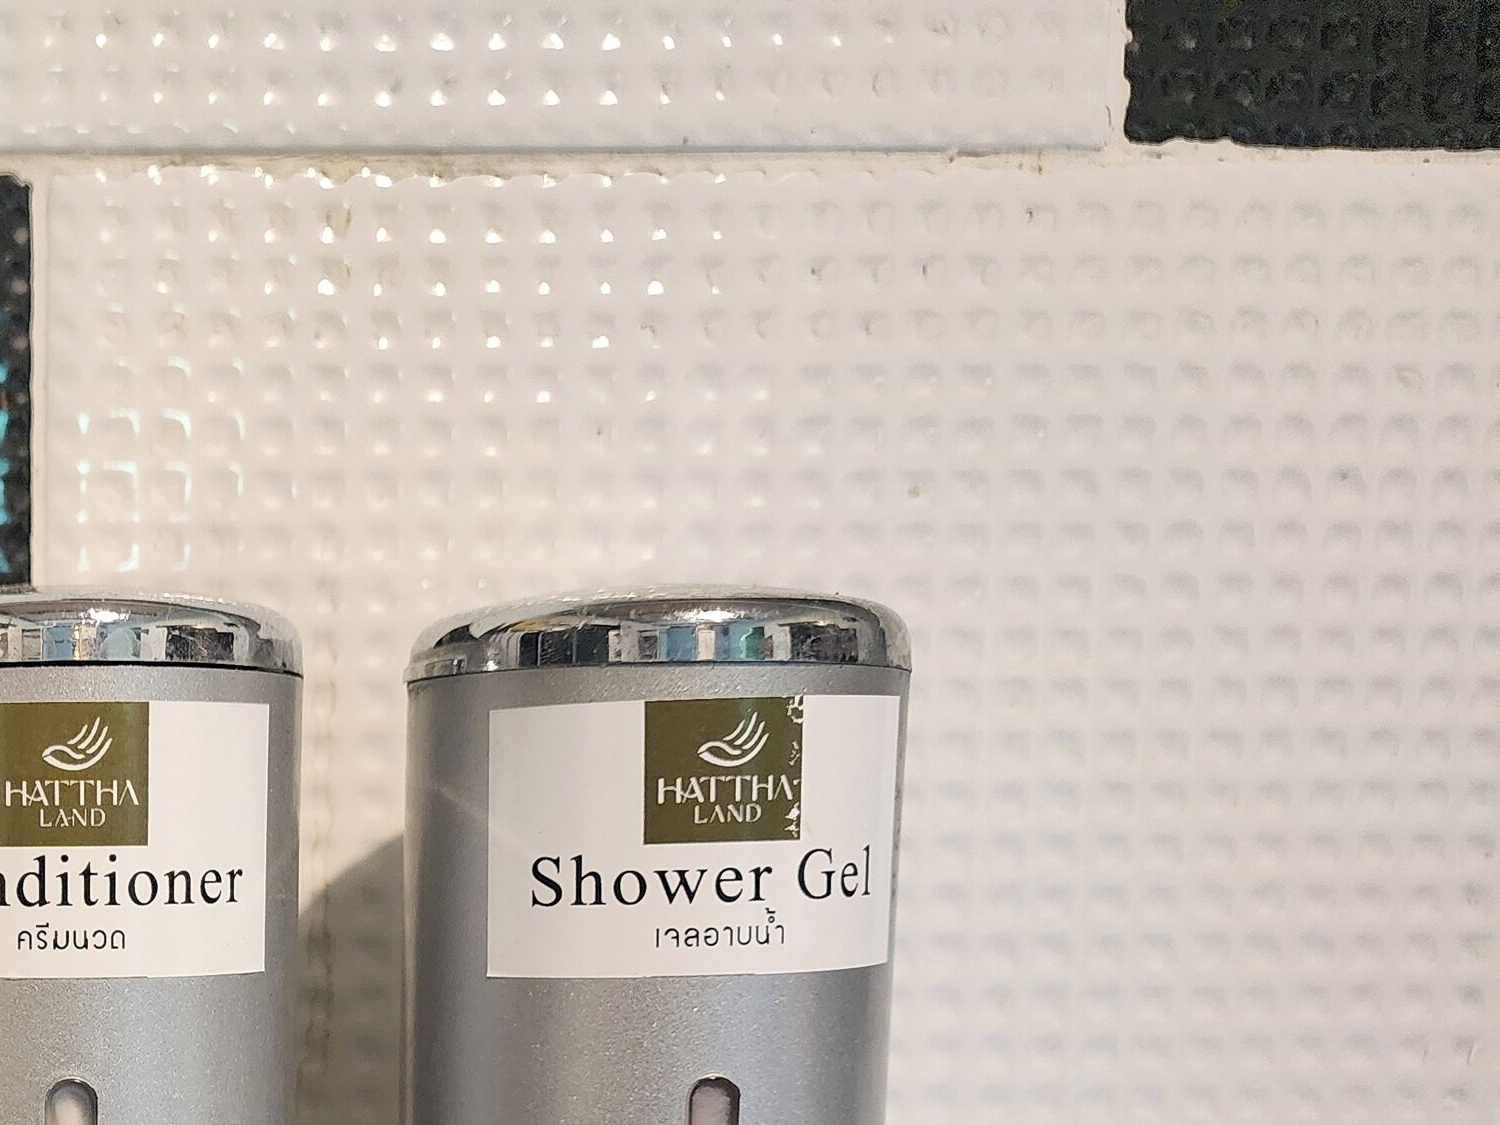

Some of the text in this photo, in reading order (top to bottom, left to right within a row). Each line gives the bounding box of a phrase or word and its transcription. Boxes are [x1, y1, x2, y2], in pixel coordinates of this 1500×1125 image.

[5, 779, 140, 807] HATTHA
[656, 773, 794, 805] HATTHA
[39, 808, 106, 828] LAND
[693, 803, 762, 824] LAND
[530, 844, 872, 908] Shower Gel
[17, 921, 126, 951] ครีมนวด
[655, 907, 786, 949] เจลอาบน้ำ
